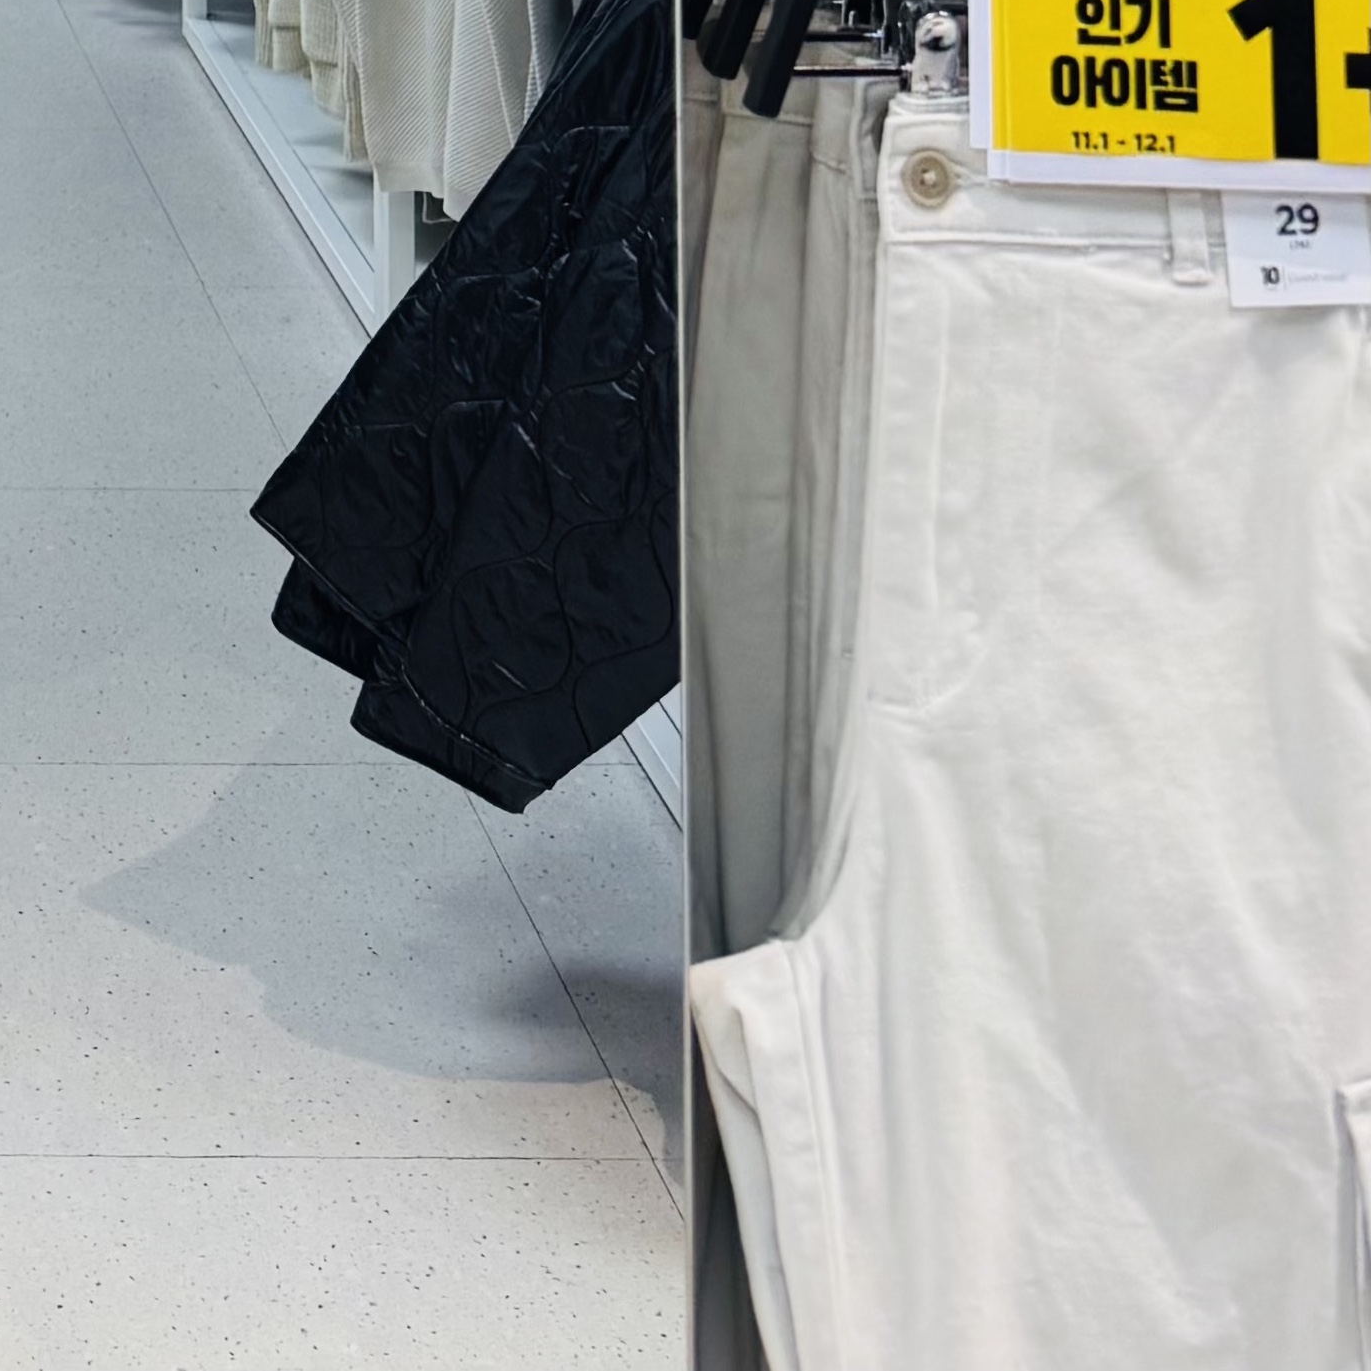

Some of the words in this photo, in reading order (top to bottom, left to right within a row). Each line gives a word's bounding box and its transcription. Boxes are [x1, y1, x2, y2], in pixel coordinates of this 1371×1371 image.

[1050, 55, 1199, 114] 아이템
[1071, 130, 1110, 151] 11.1
[1133, 133, 1176, 154] 12.1
[1275, 203, 1320, 236] 29
